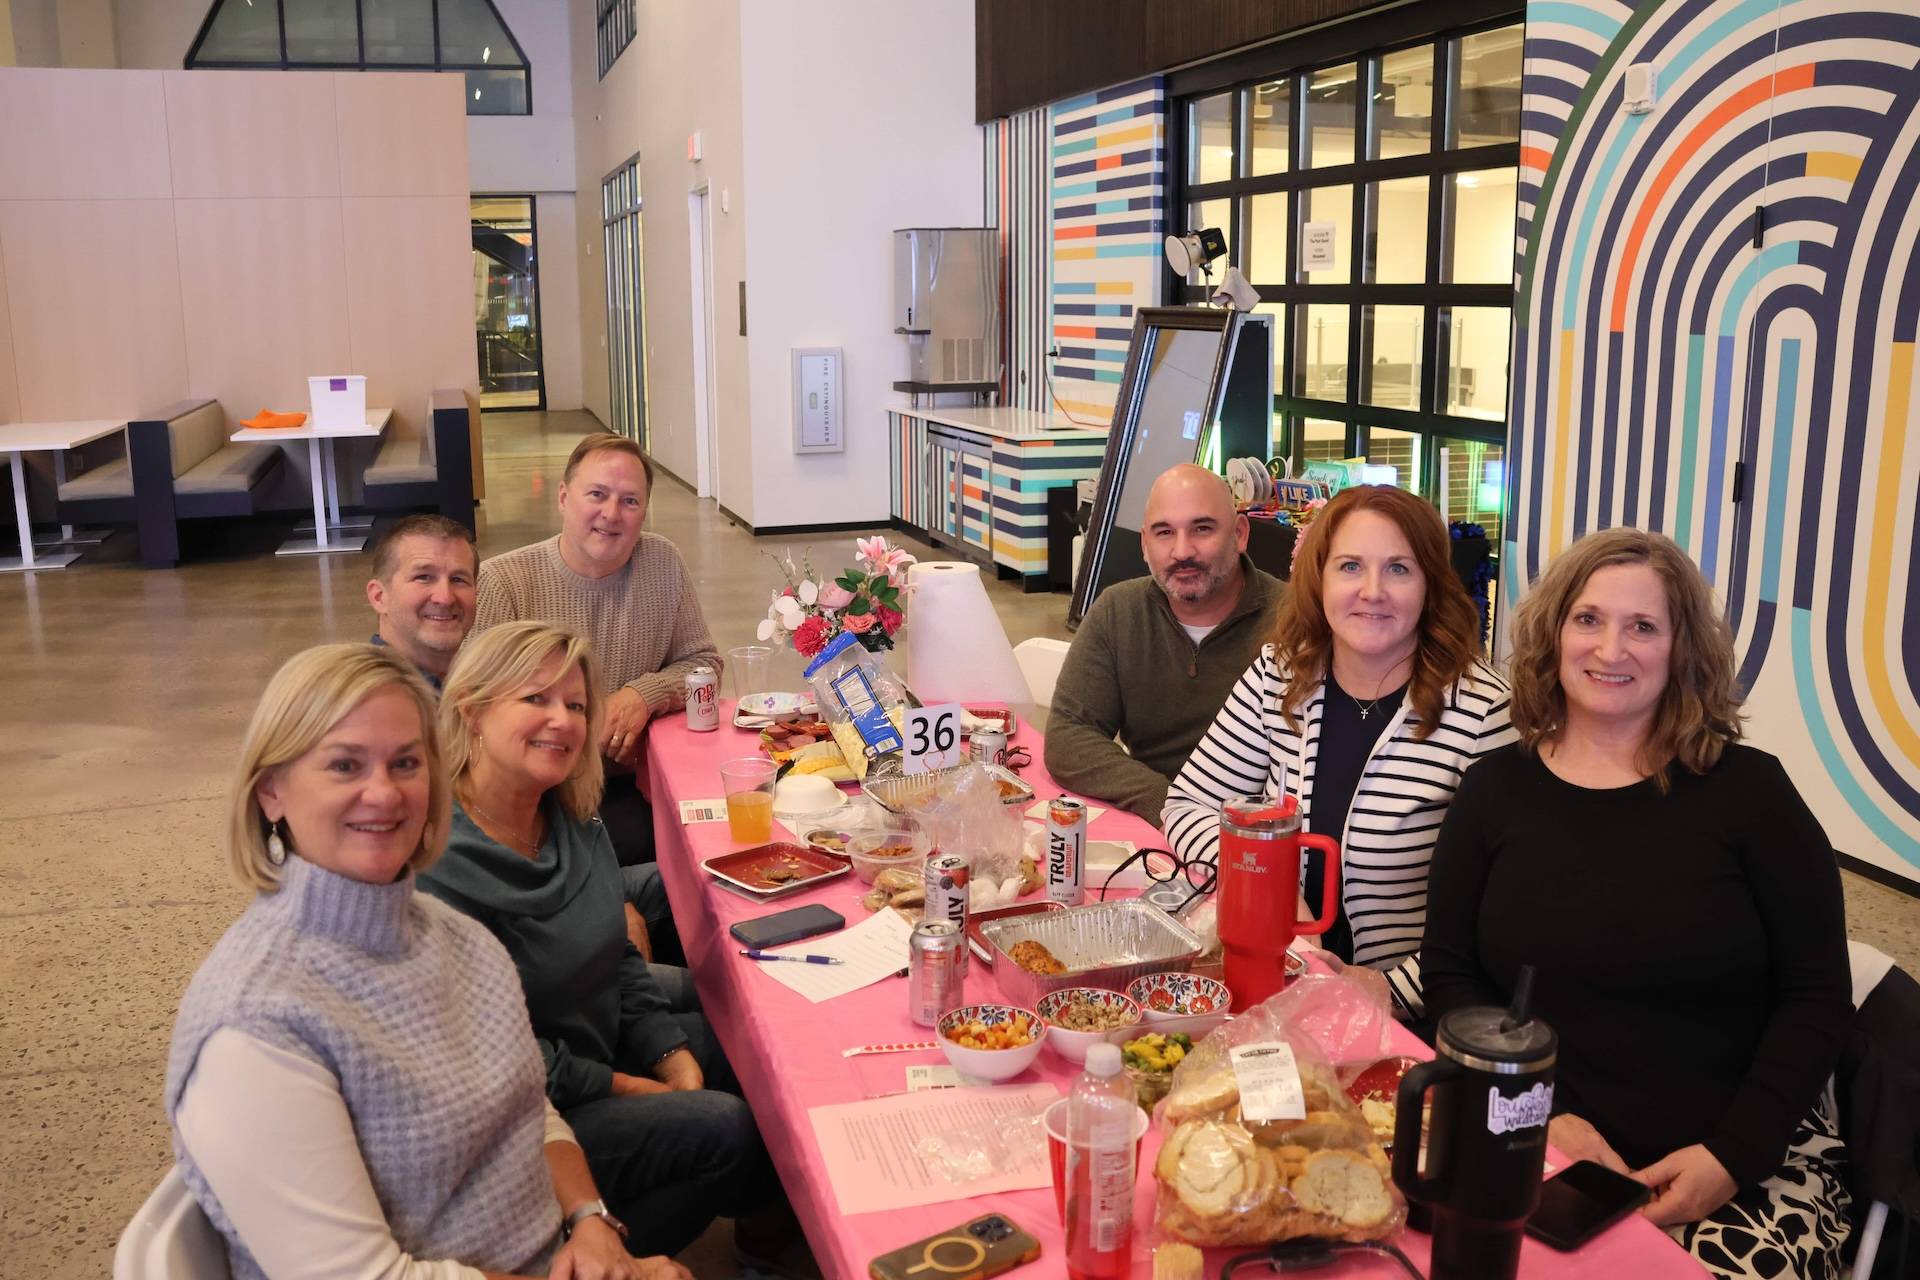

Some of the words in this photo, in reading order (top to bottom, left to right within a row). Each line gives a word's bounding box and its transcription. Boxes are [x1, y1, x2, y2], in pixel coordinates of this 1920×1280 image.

[911, 713, 954, 756] 36
[1050, 832, 1065, 885] TRULY
[1232, 862, 1267, 873] STANLEY
[948, 897, 964, 933] ULY
